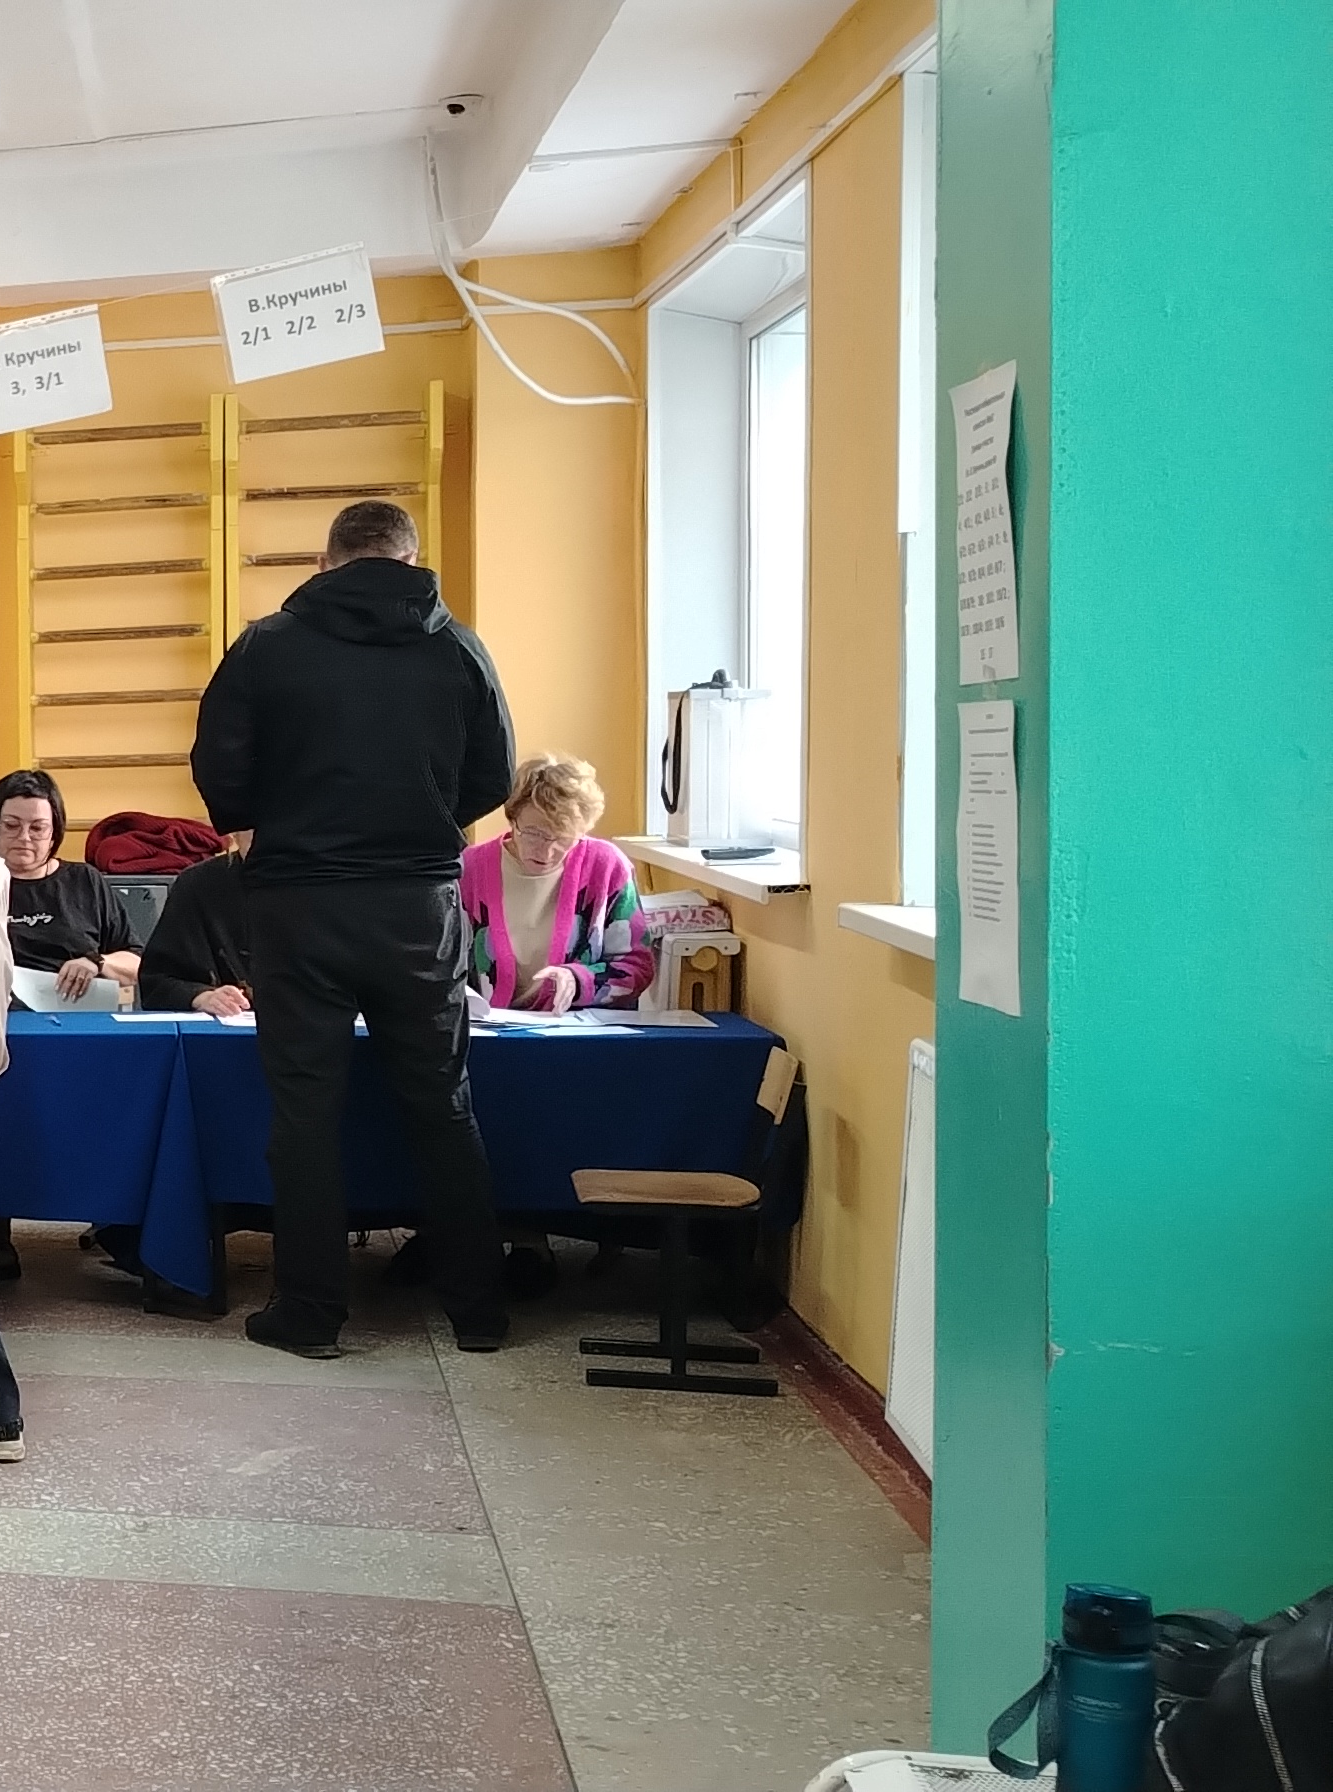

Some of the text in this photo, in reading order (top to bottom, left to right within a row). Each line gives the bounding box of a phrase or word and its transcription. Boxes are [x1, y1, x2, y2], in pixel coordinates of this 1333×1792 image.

[248, 280, 348, 313] В.Кручины
[241, 303, 367, 346] 2/1 2/2 2/3
[4, 341, 82, 368] Кручины
[10, 372, 64, 396] 3, 3/1
